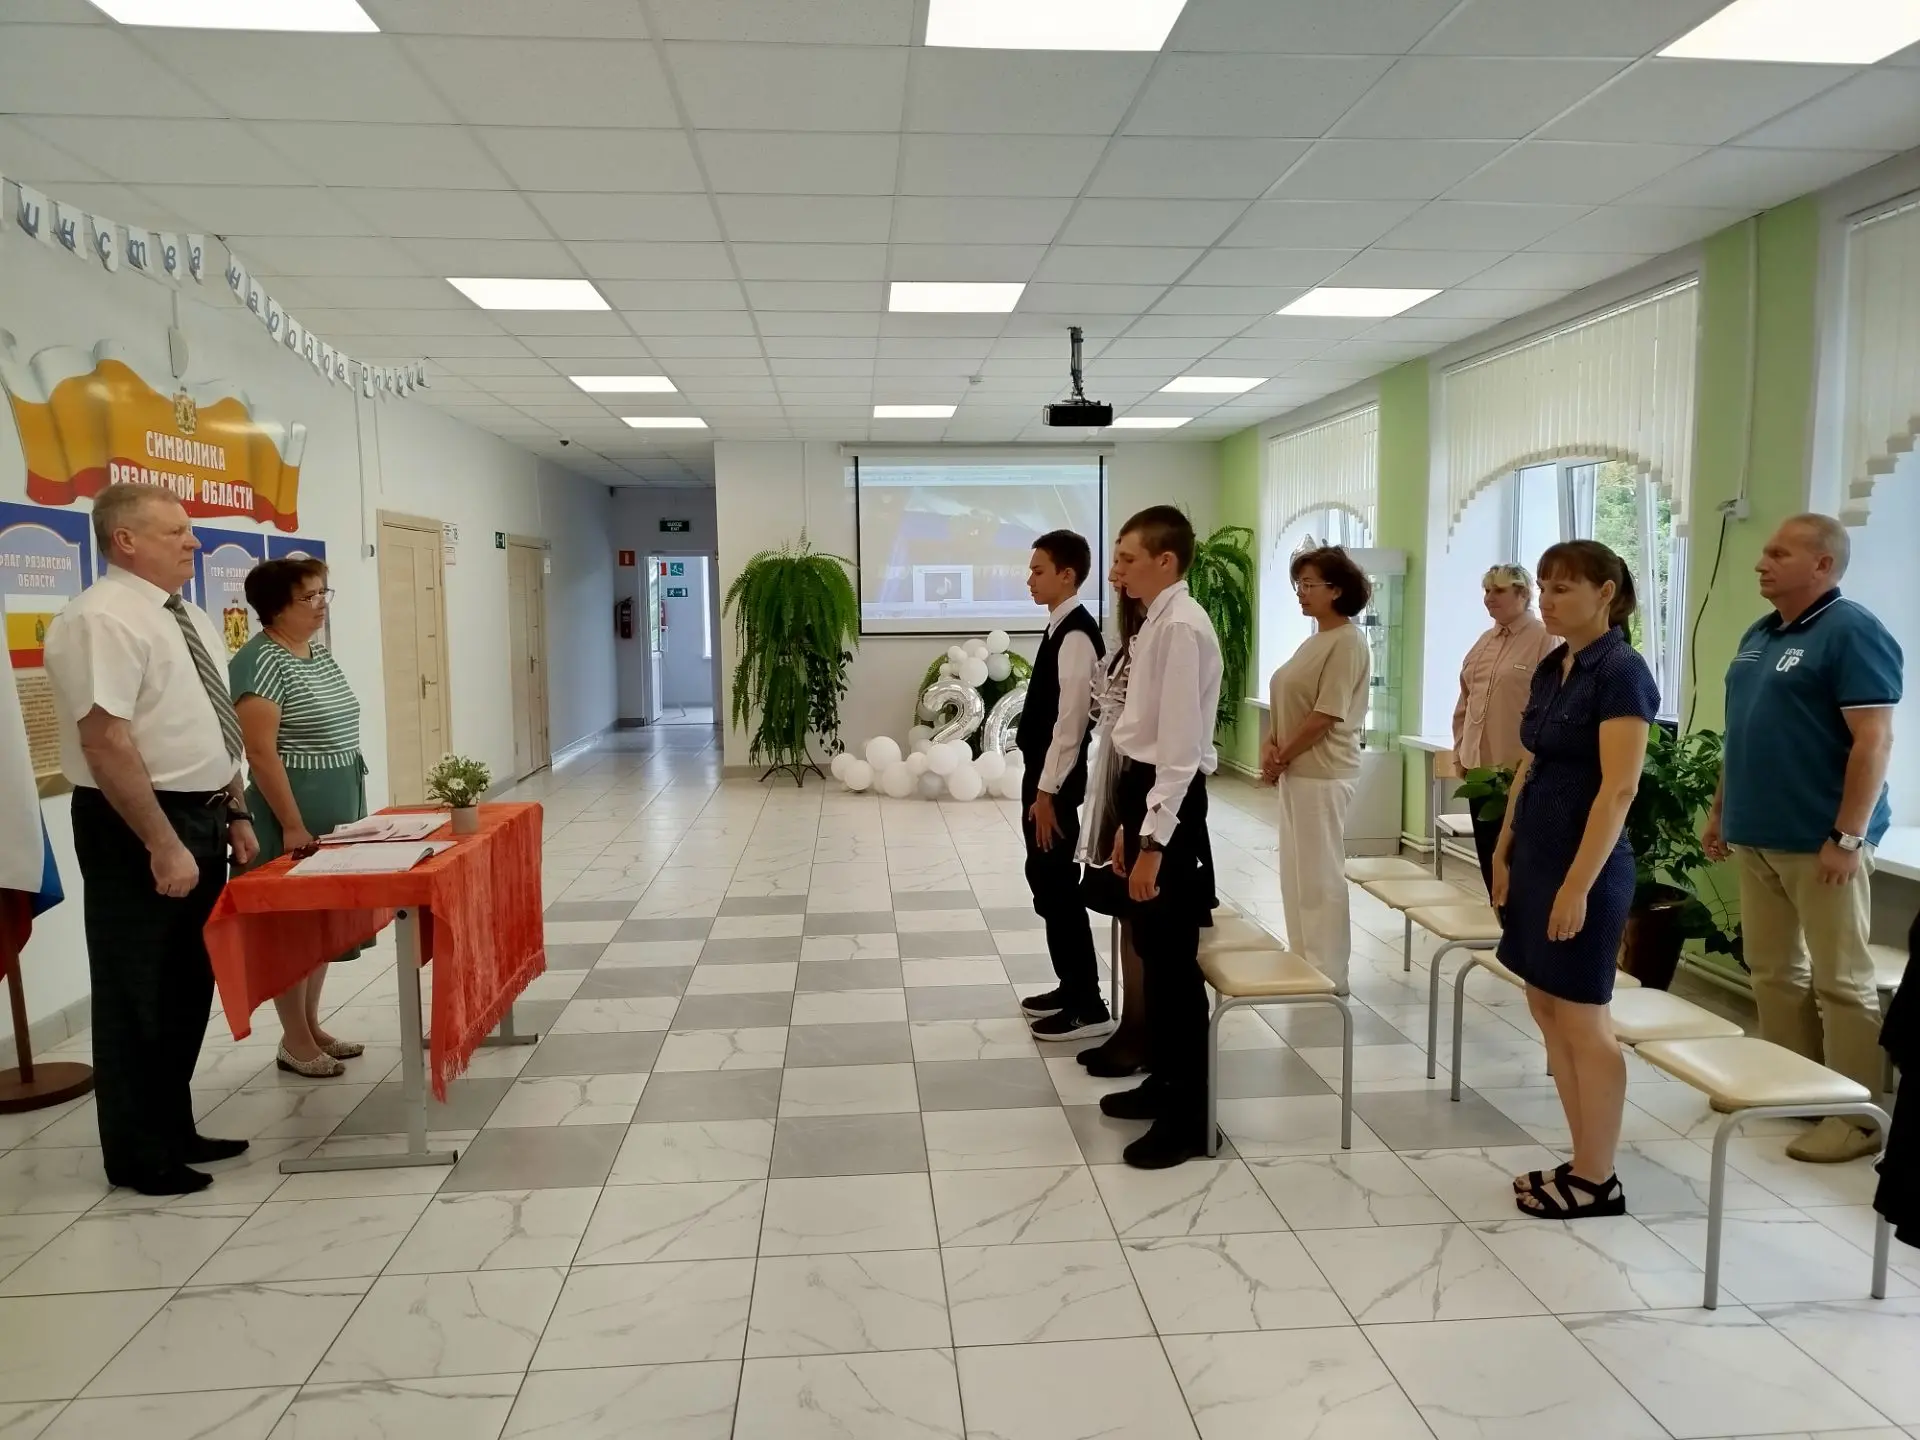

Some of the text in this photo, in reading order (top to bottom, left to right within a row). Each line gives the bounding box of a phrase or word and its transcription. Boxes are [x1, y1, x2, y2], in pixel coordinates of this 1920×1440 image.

[24, 202, 201, 271] инства
[145, 430, 226, 471] СИМВОЛИКА
[202, 479, 254, 510] ОБЛАСТИ
[25, 553, 72, 571] РЯЗАНСКОЙ
[17, 573, 56, 589] ОБЛАСТИ
[1775, 655, 1800, 672] UP
